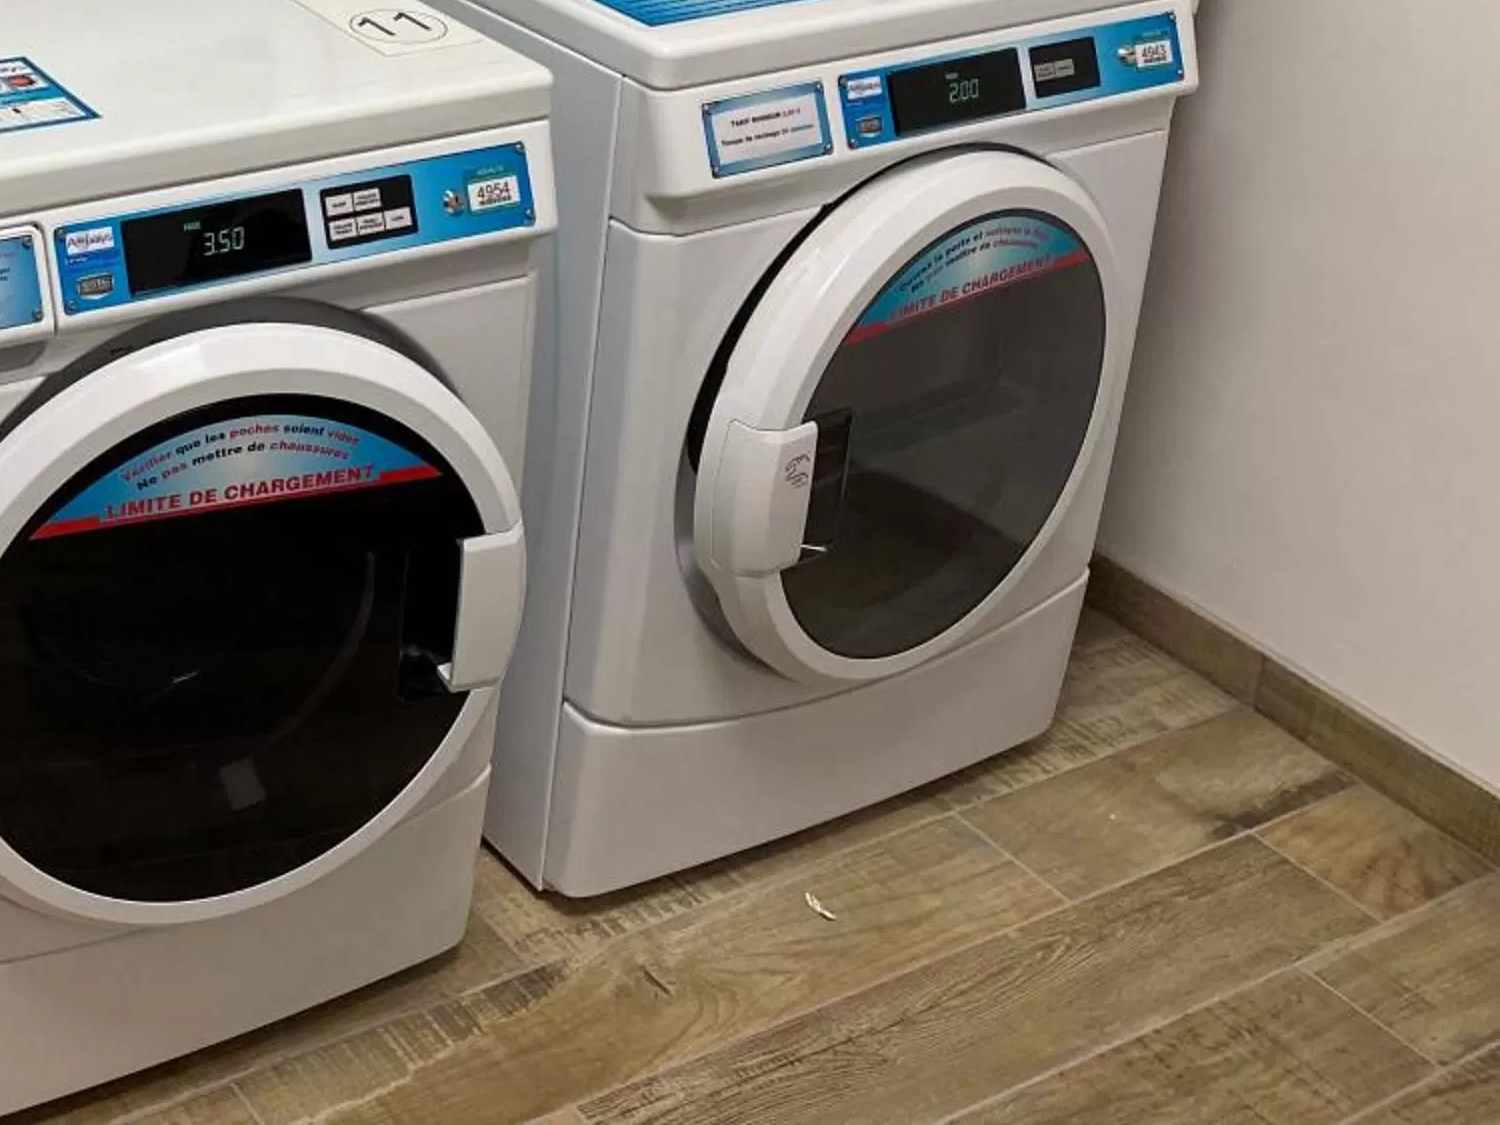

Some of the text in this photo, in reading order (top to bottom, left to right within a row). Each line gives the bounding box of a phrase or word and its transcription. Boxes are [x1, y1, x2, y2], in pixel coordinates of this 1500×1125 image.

[358, 12, 431, 36] 11
[176, 439, 201, 457] que
[205, 432, 226, 443] les
[229, 424, 279, 440] poches
[284, 424, 325, 437] soient
[137, 476, 158, 490] Ne
[192, 445, 243, 466] mettre
[248, 441, 265, 453] de
[106, 464, 374, 520] LIMITE DE CHARGEMENT
